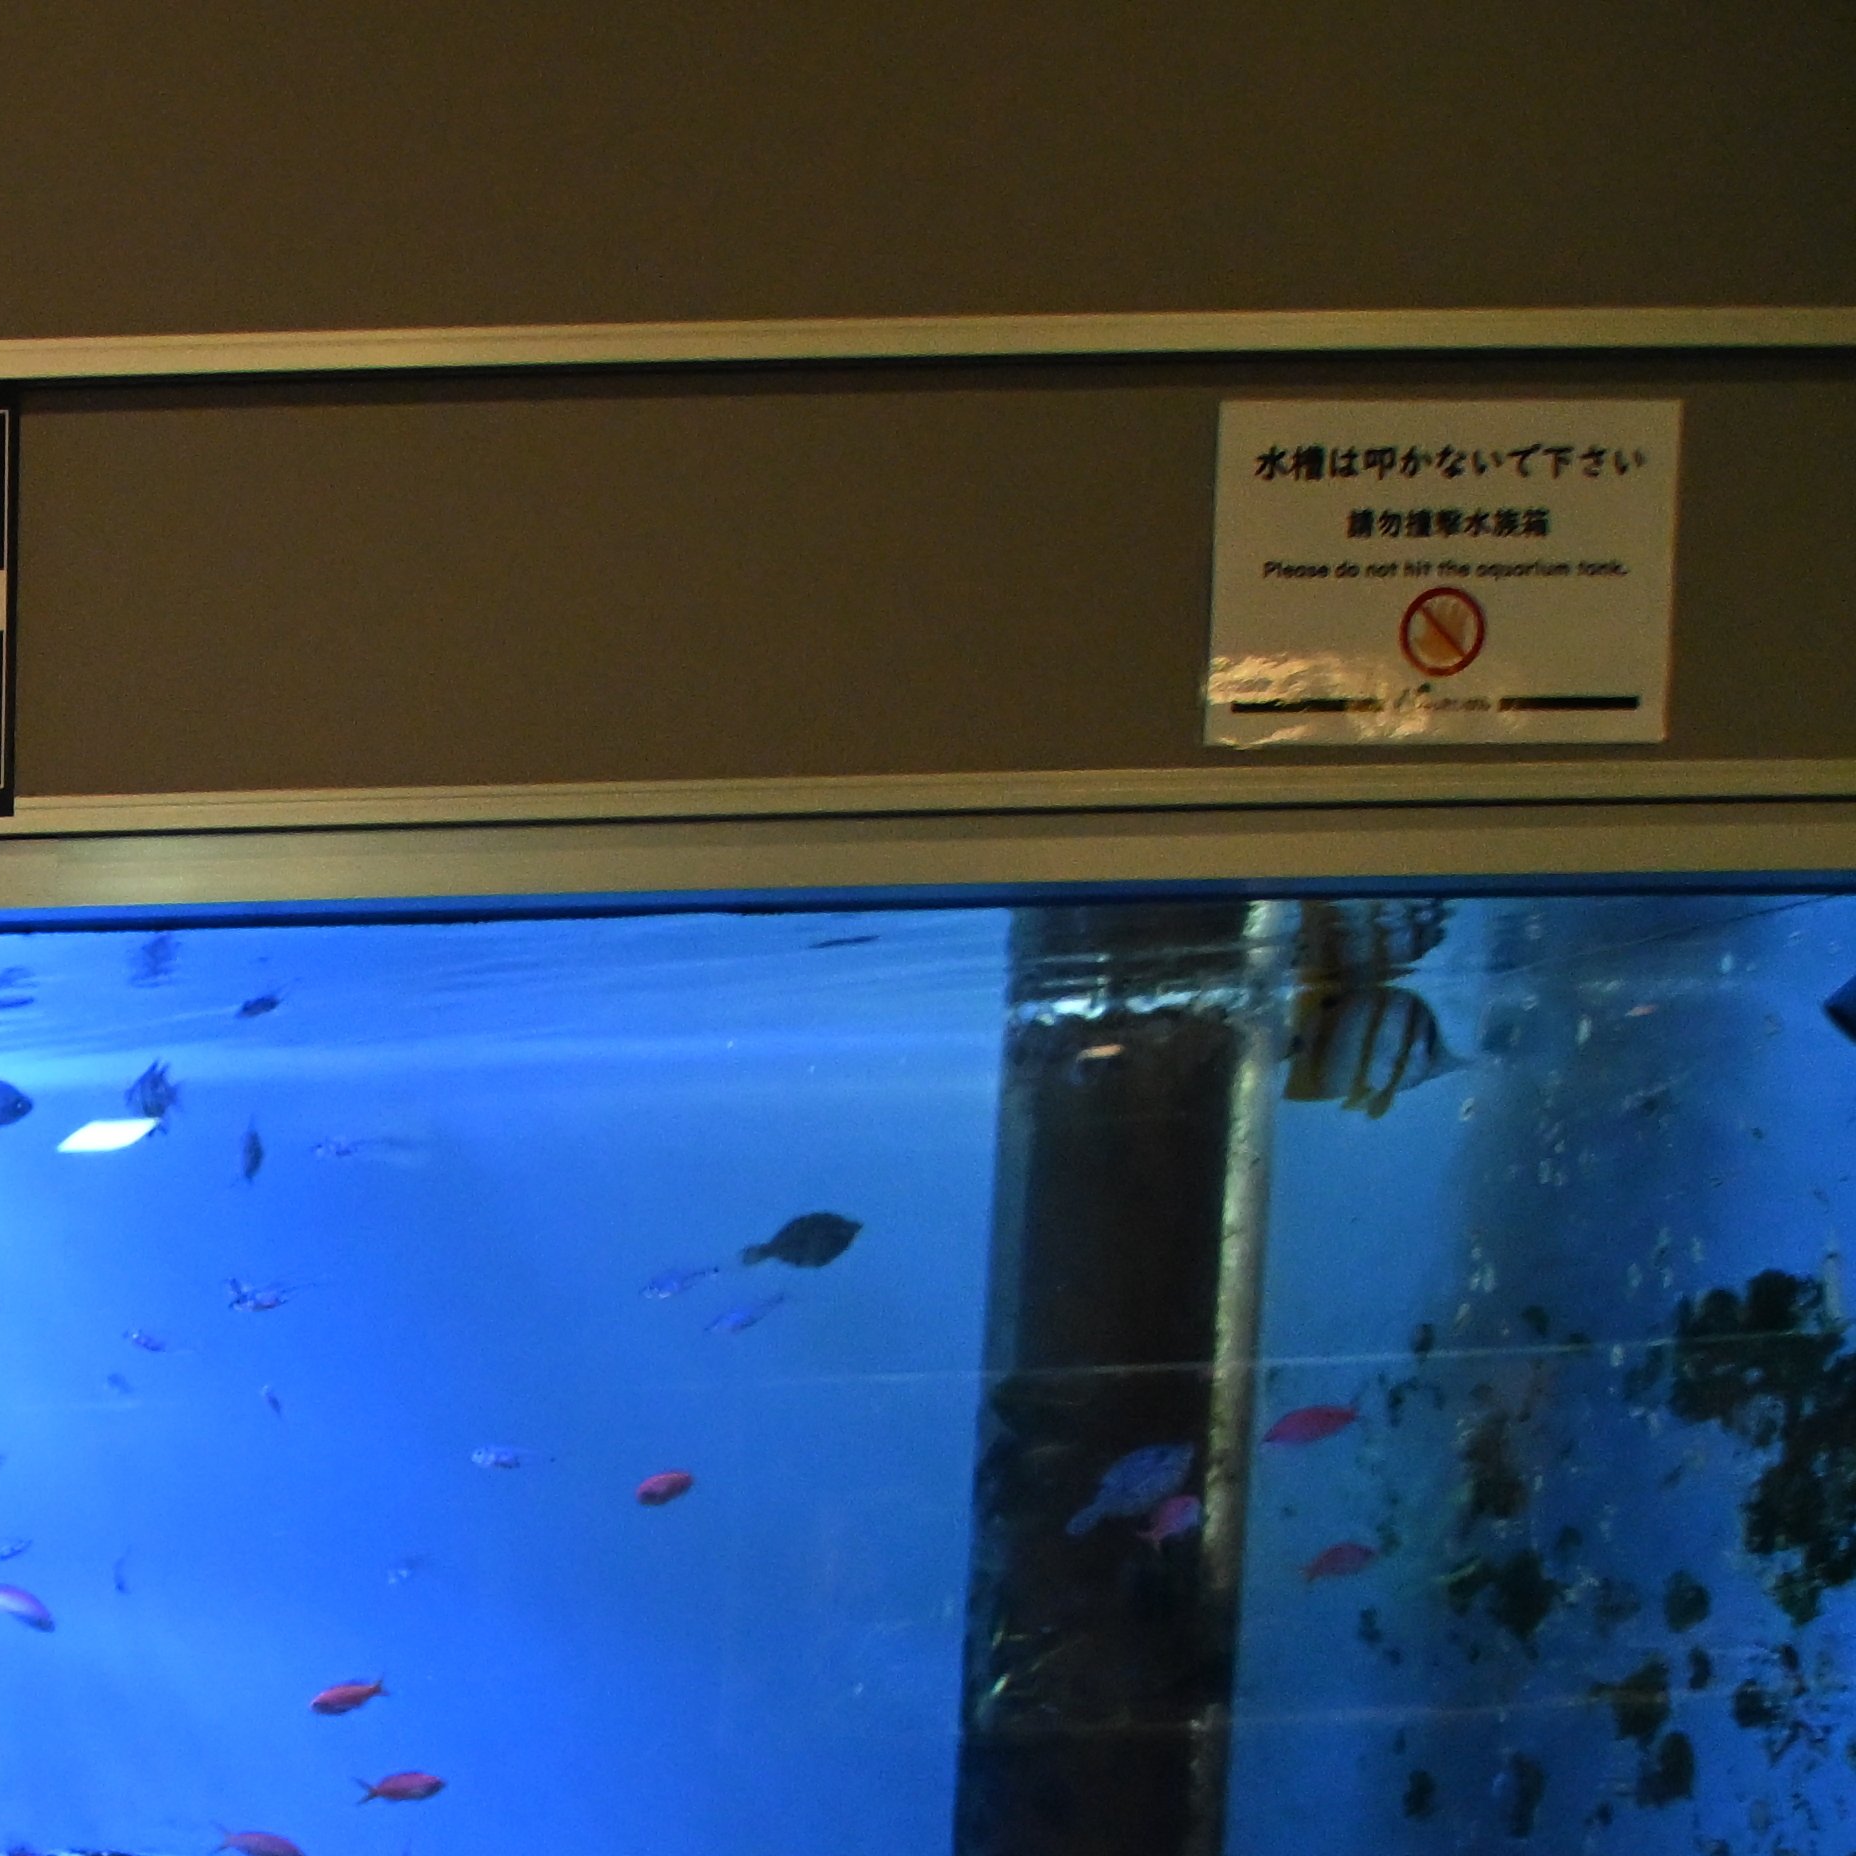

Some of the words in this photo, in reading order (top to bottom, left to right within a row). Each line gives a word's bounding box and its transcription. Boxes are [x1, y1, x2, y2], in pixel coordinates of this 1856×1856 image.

[1255, 445, 1645, 480] 水槽は叩かないで下さい
[1264, 562, 1328, 579] Please
[1336, 562, 1359, 578] do
[1367, 563, 1396, 578] not
[1404, 562, 1432, 578] hit
[1437, 562, 1469, 578] the
[1476, 562, 1569, 581] aquarium
[1578, 561, 1629, 577] tank.
